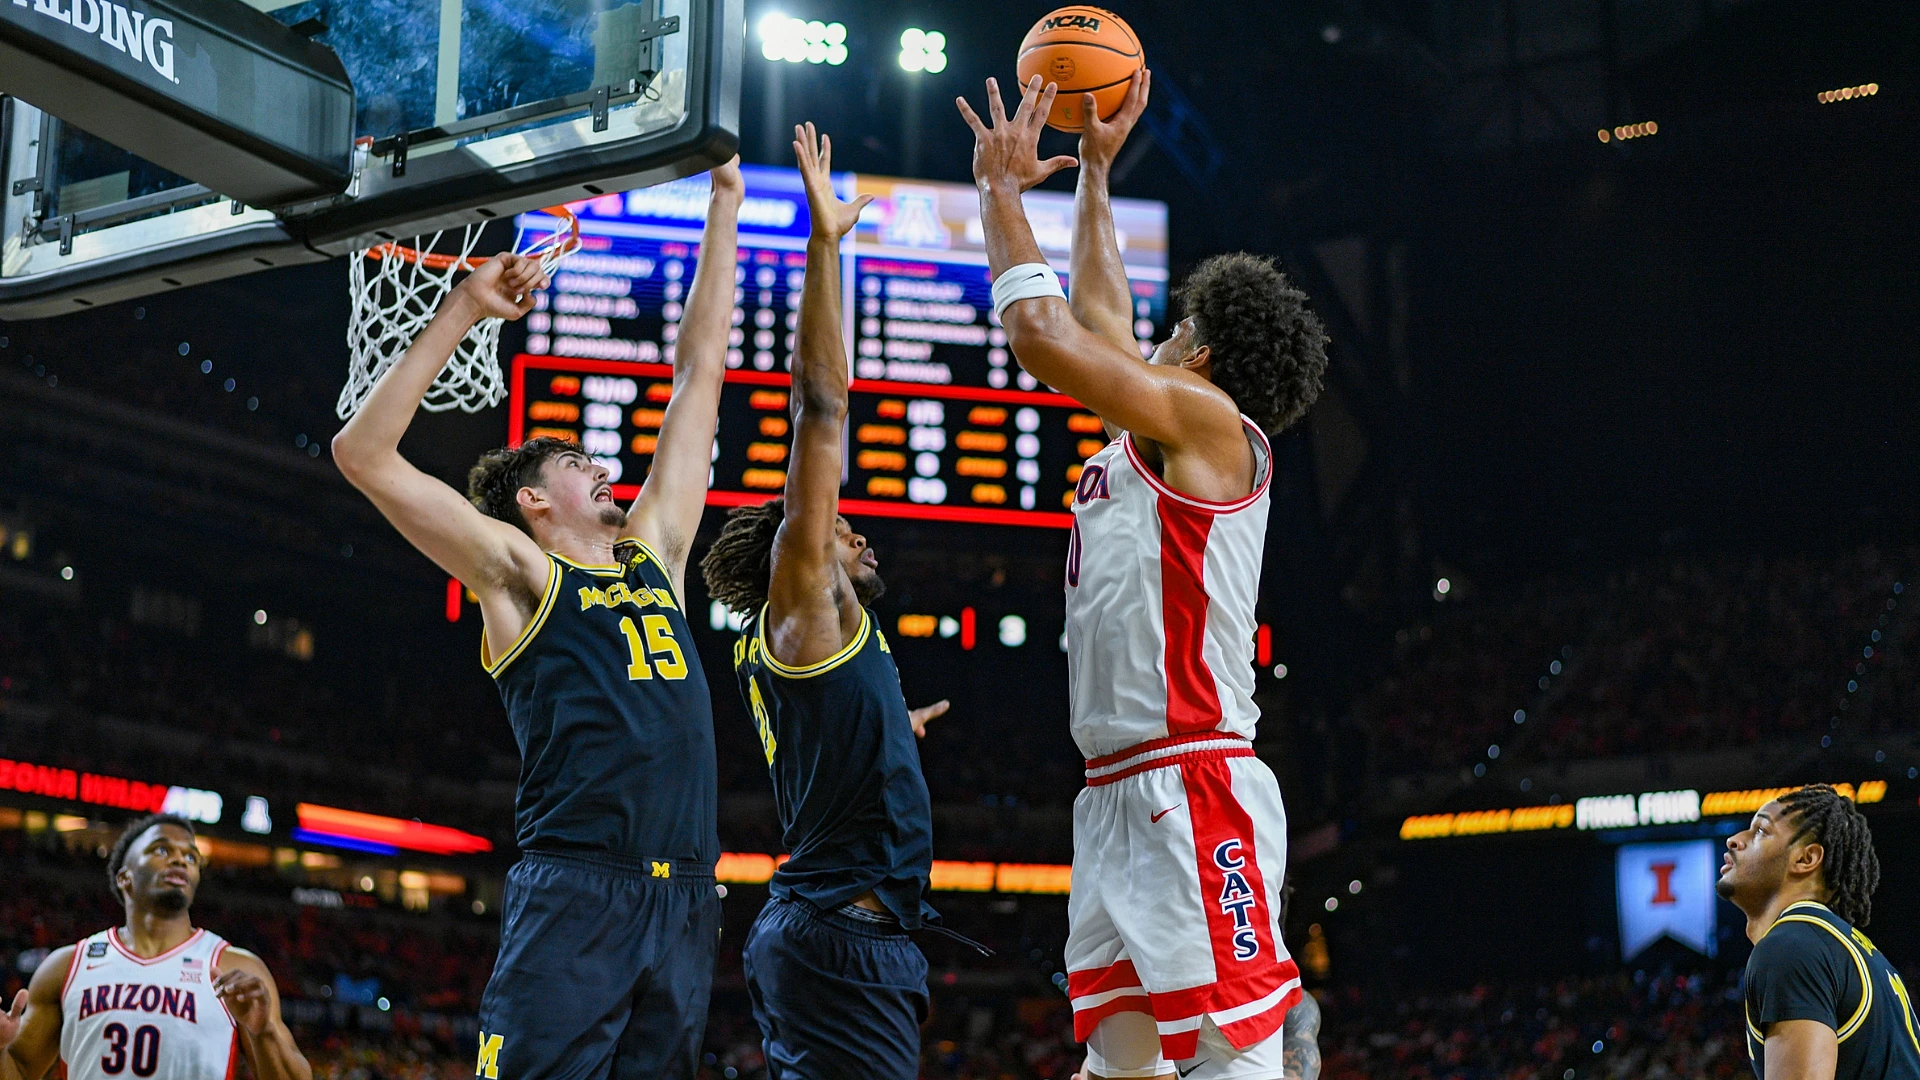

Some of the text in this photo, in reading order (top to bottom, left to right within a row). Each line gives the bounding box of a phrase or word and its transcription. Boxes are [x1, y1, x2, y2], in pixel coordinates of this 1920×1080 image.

[1040, 15, 1100, 32] NCAA
[618, 614, 689, 681] 15
[1576, 794, 1638, 830] FINAL
[1638, 789, 1700, 826] FOUR
[651, 861, 670, 879] M
[1213, 838, 1259, 961] CATS
[78, 984, 198, 1024] ARIZONA
[101, 1022, 161, 1078] 30
[475, 1030, 504, 1080] M
